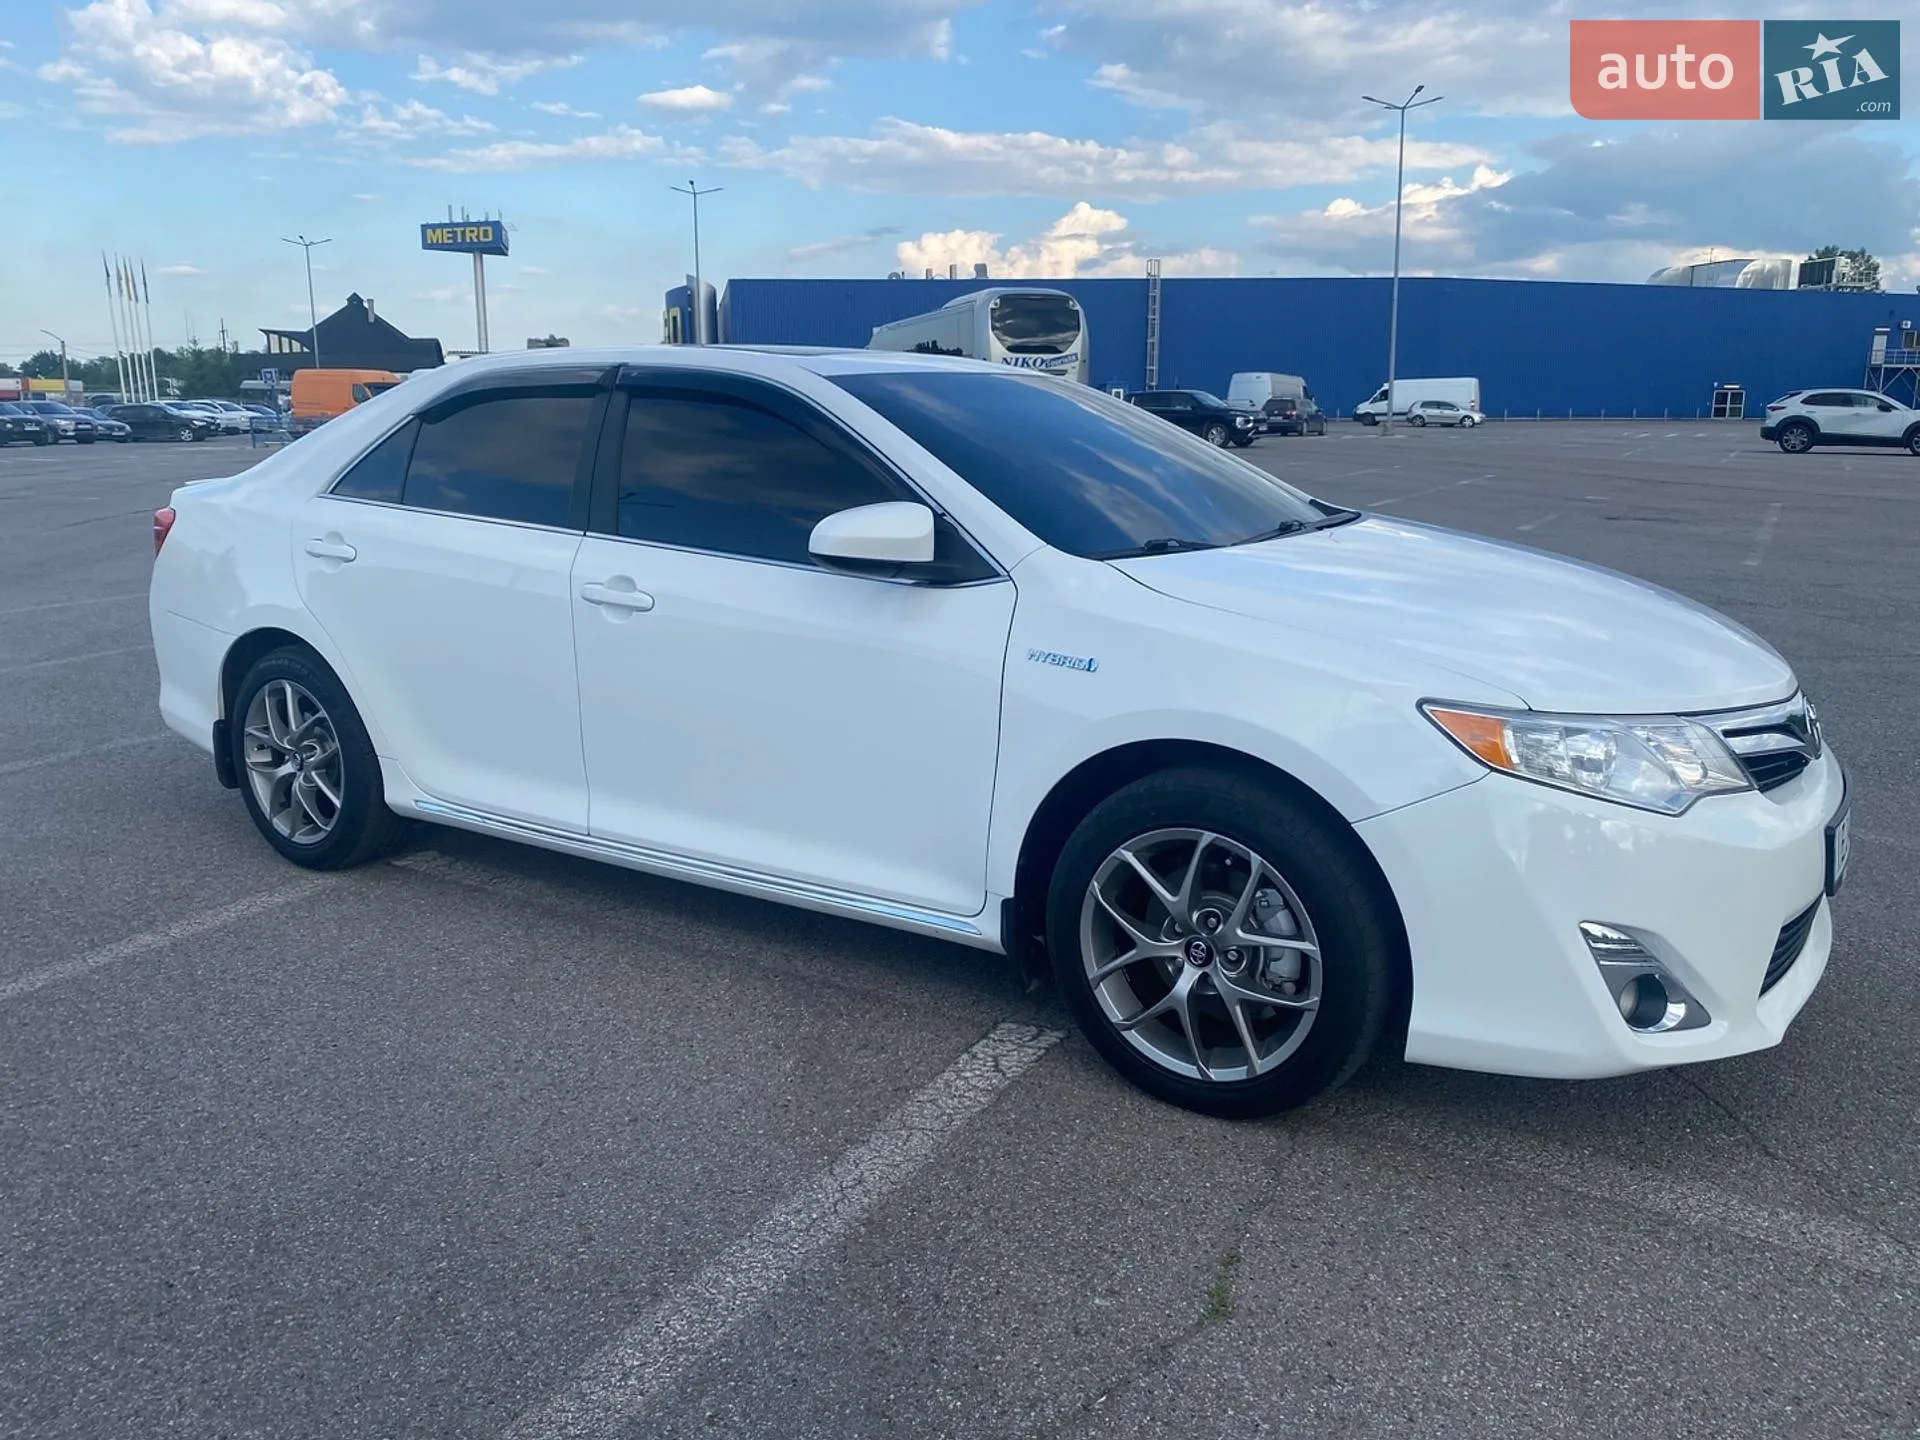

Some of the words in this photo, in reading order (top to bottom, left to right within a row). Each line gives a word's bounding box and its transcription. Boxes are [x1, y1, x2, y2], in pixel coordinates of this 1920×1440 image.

[426, 226, 493, 244] METRO
[1001, 356, 1044, 368] NIKO
[1027, 647, 1099, 673] HYBRID
